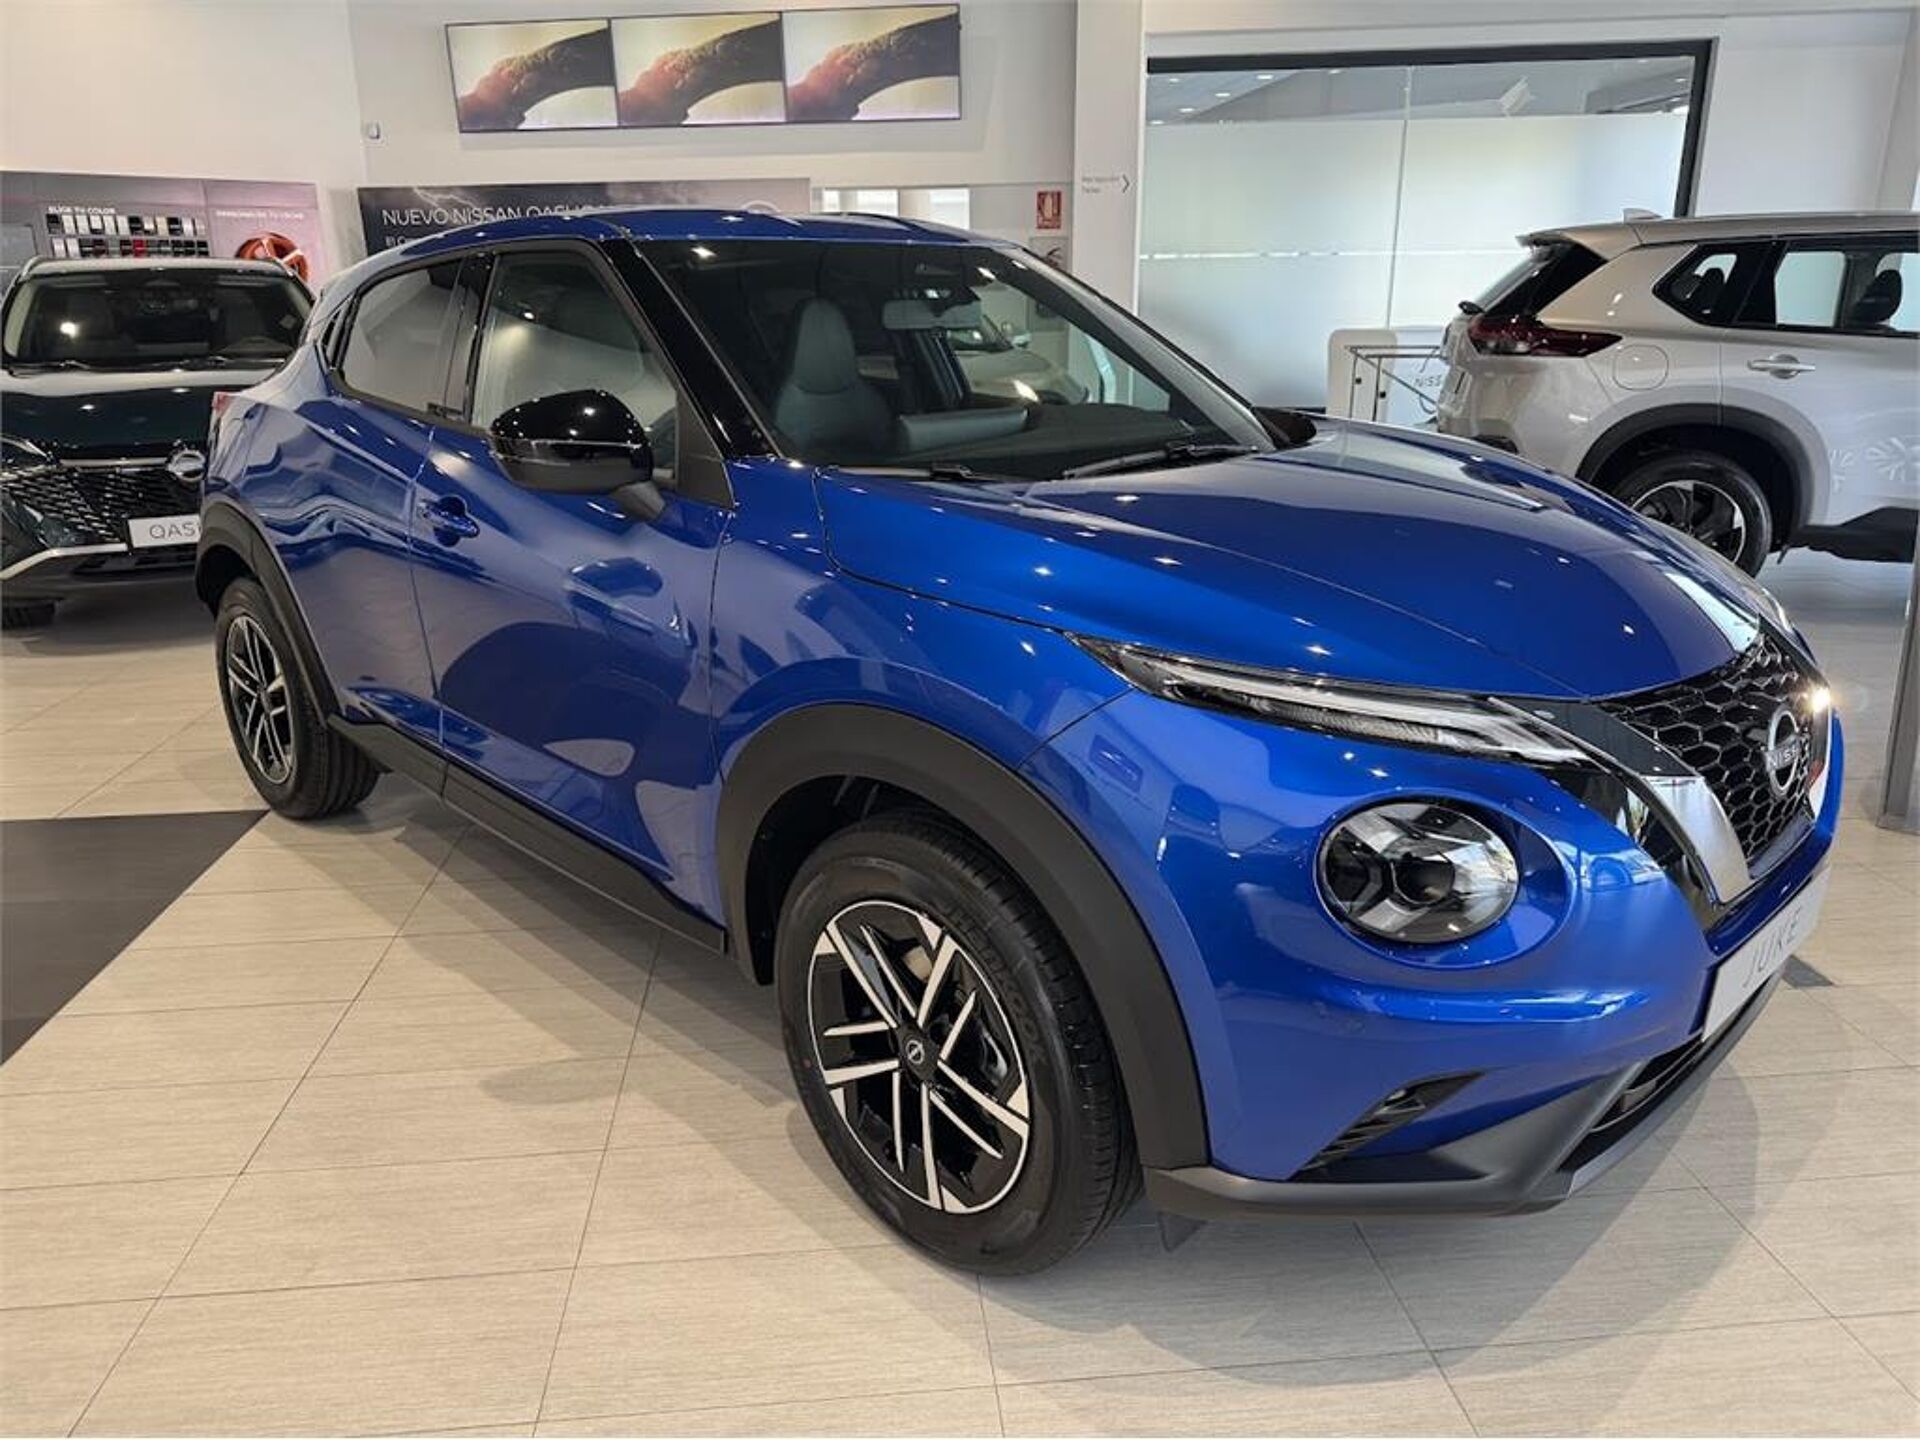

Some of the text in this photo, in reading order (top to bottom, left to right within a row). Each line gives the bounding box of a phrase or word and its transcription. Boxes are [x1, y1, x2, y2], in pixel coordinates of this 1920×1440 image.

[382, 207, 448, 226] NUEVO
[452, 204, 520, 224] NISSAN
[1741, 904, 1803, 989] JUKE
